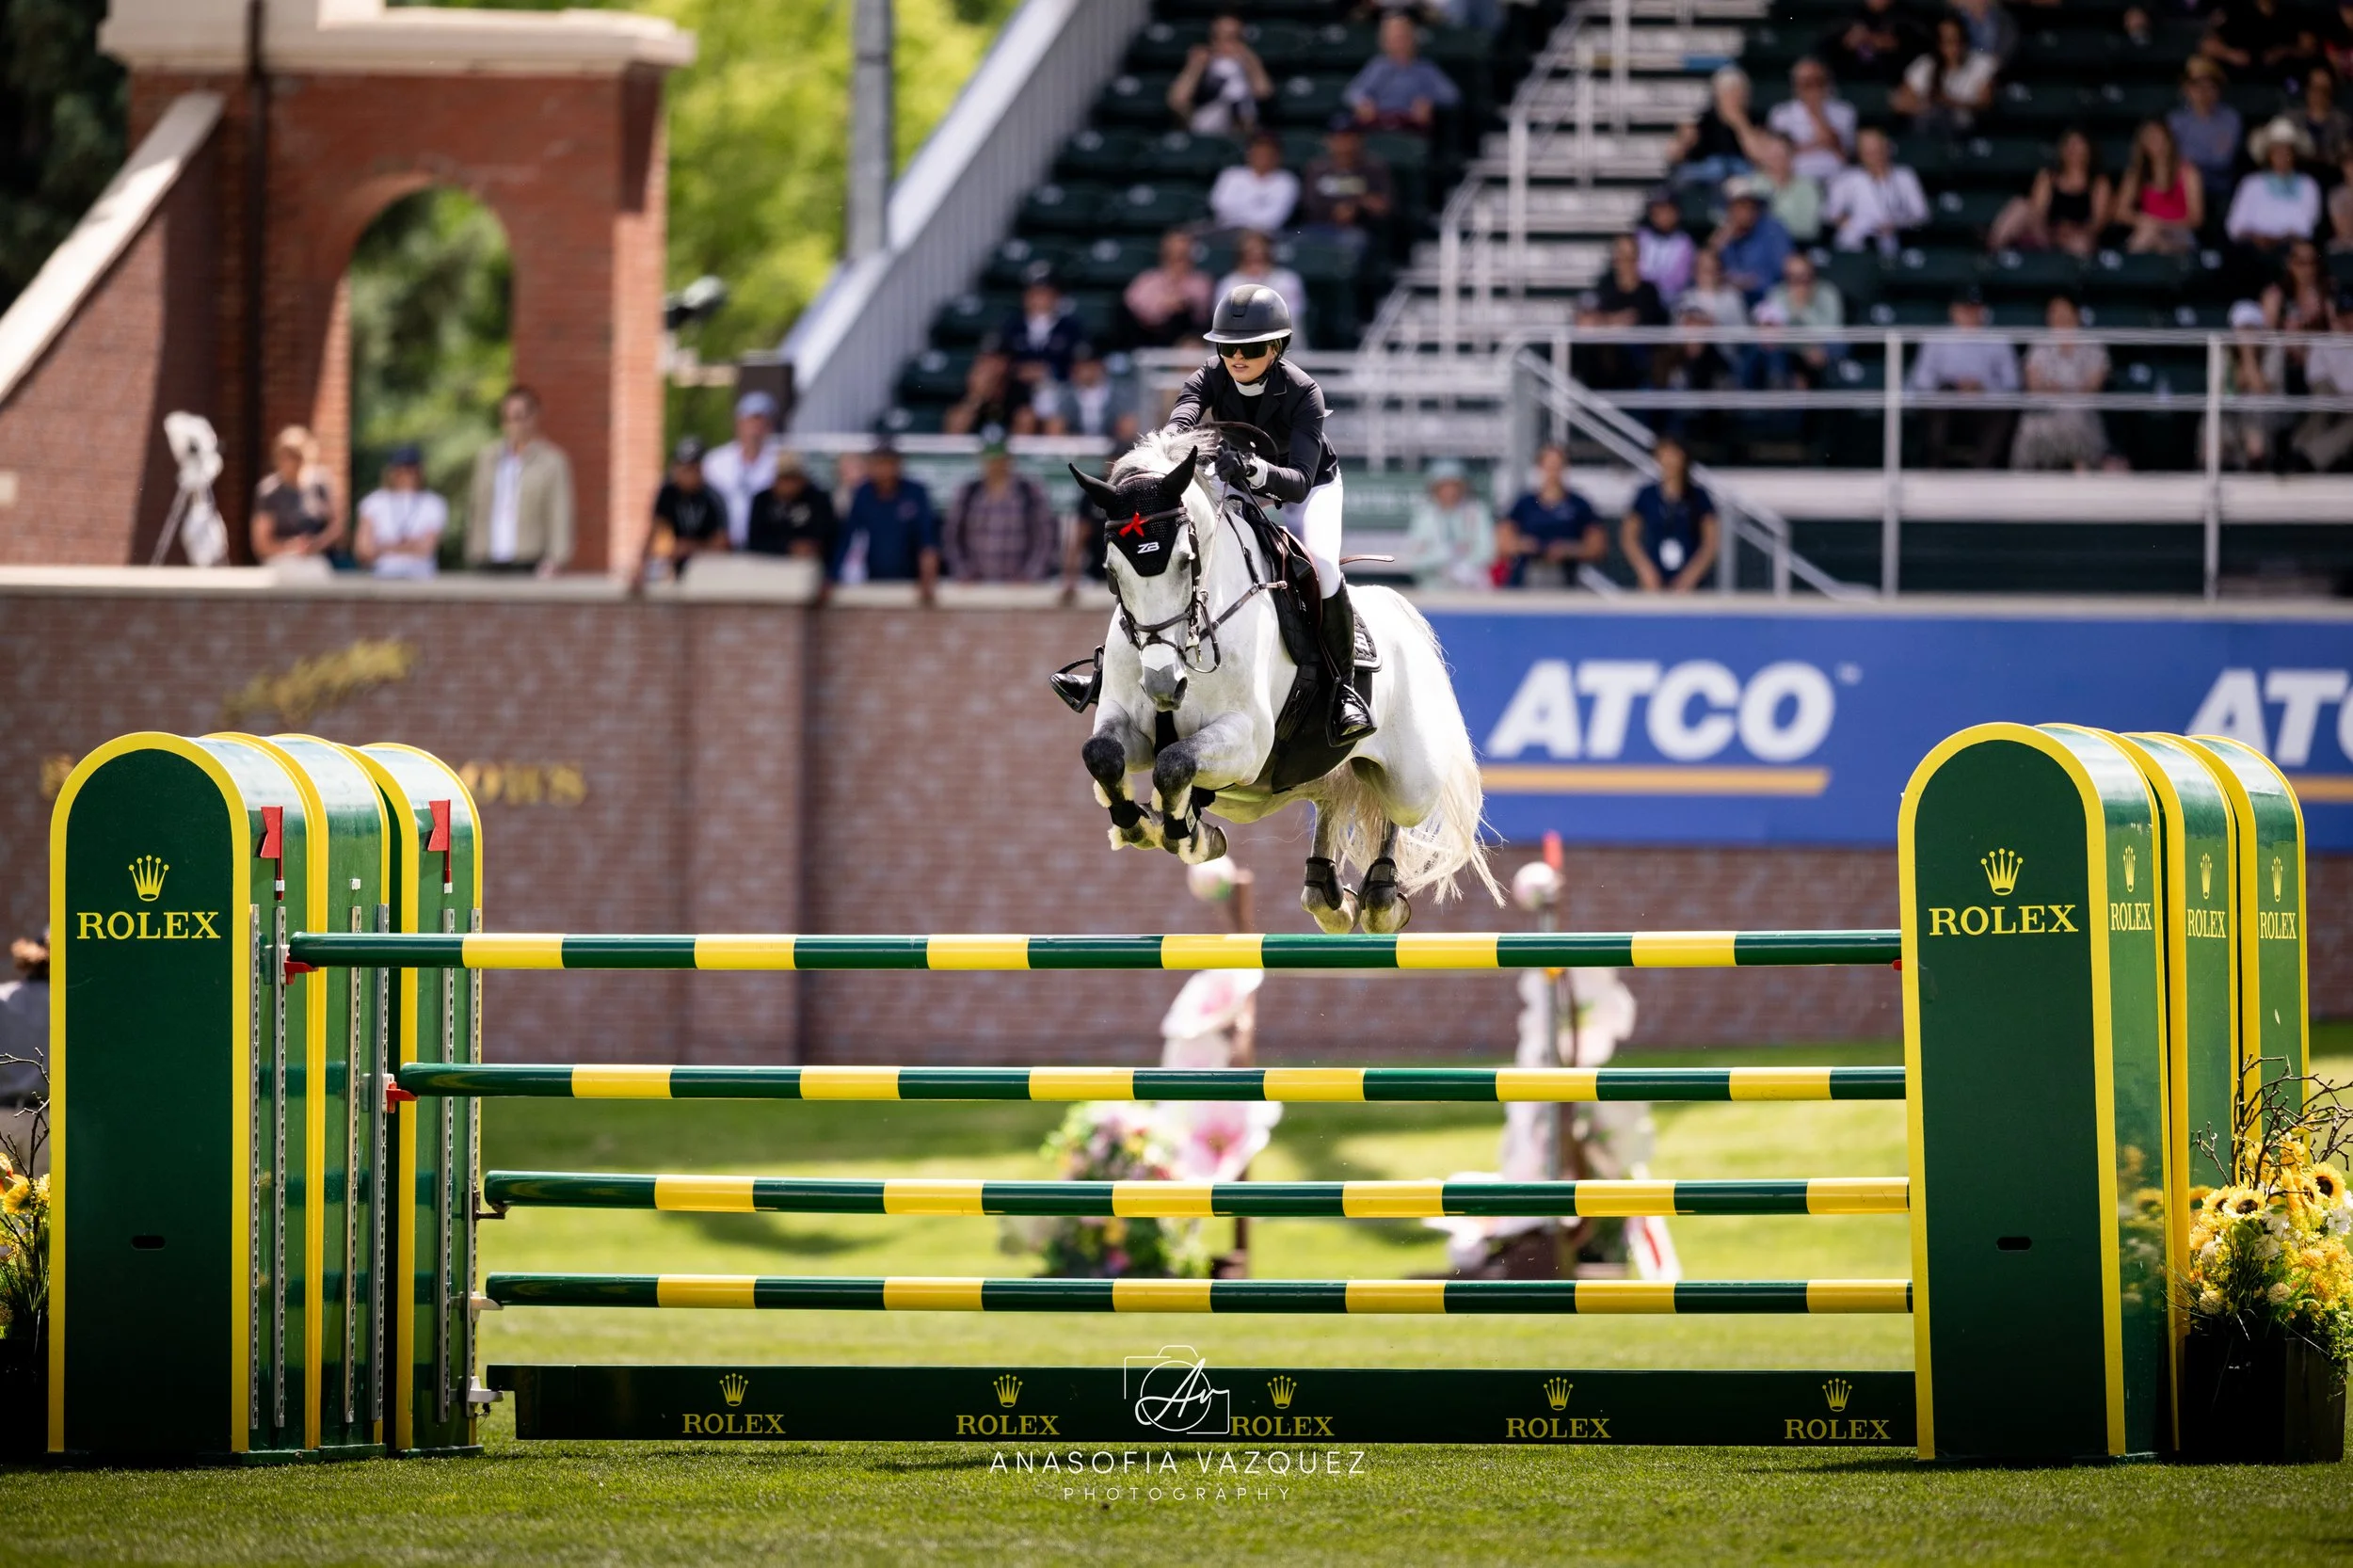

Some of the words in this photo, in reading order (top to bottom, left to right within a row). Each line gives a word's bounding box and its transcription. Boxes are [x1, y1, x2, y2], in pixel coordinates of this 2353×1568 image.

[1485, 659, 1835, 762] ATCO
[2184, 667, 2353, 766] AT
[76, 911, 221, 939] ROLEX
[1929, 904, 2079, 936] ROLEX
[2109, 902, 2153, 932] ROLEX
[2186, 908, 2227, 938] ROLEX
[2259, 911, 2297, 939] ROLEX
[681, 1414, 786, 1434] ROLEX
[955, 1415, 1061, 1435] ROLEX
[1229, 1416, 1335, 1437] ROLEX
[1505, 1417, 1612, 1439] ROLEX
[1784, 1418, 1891, 1440] ROLEX
